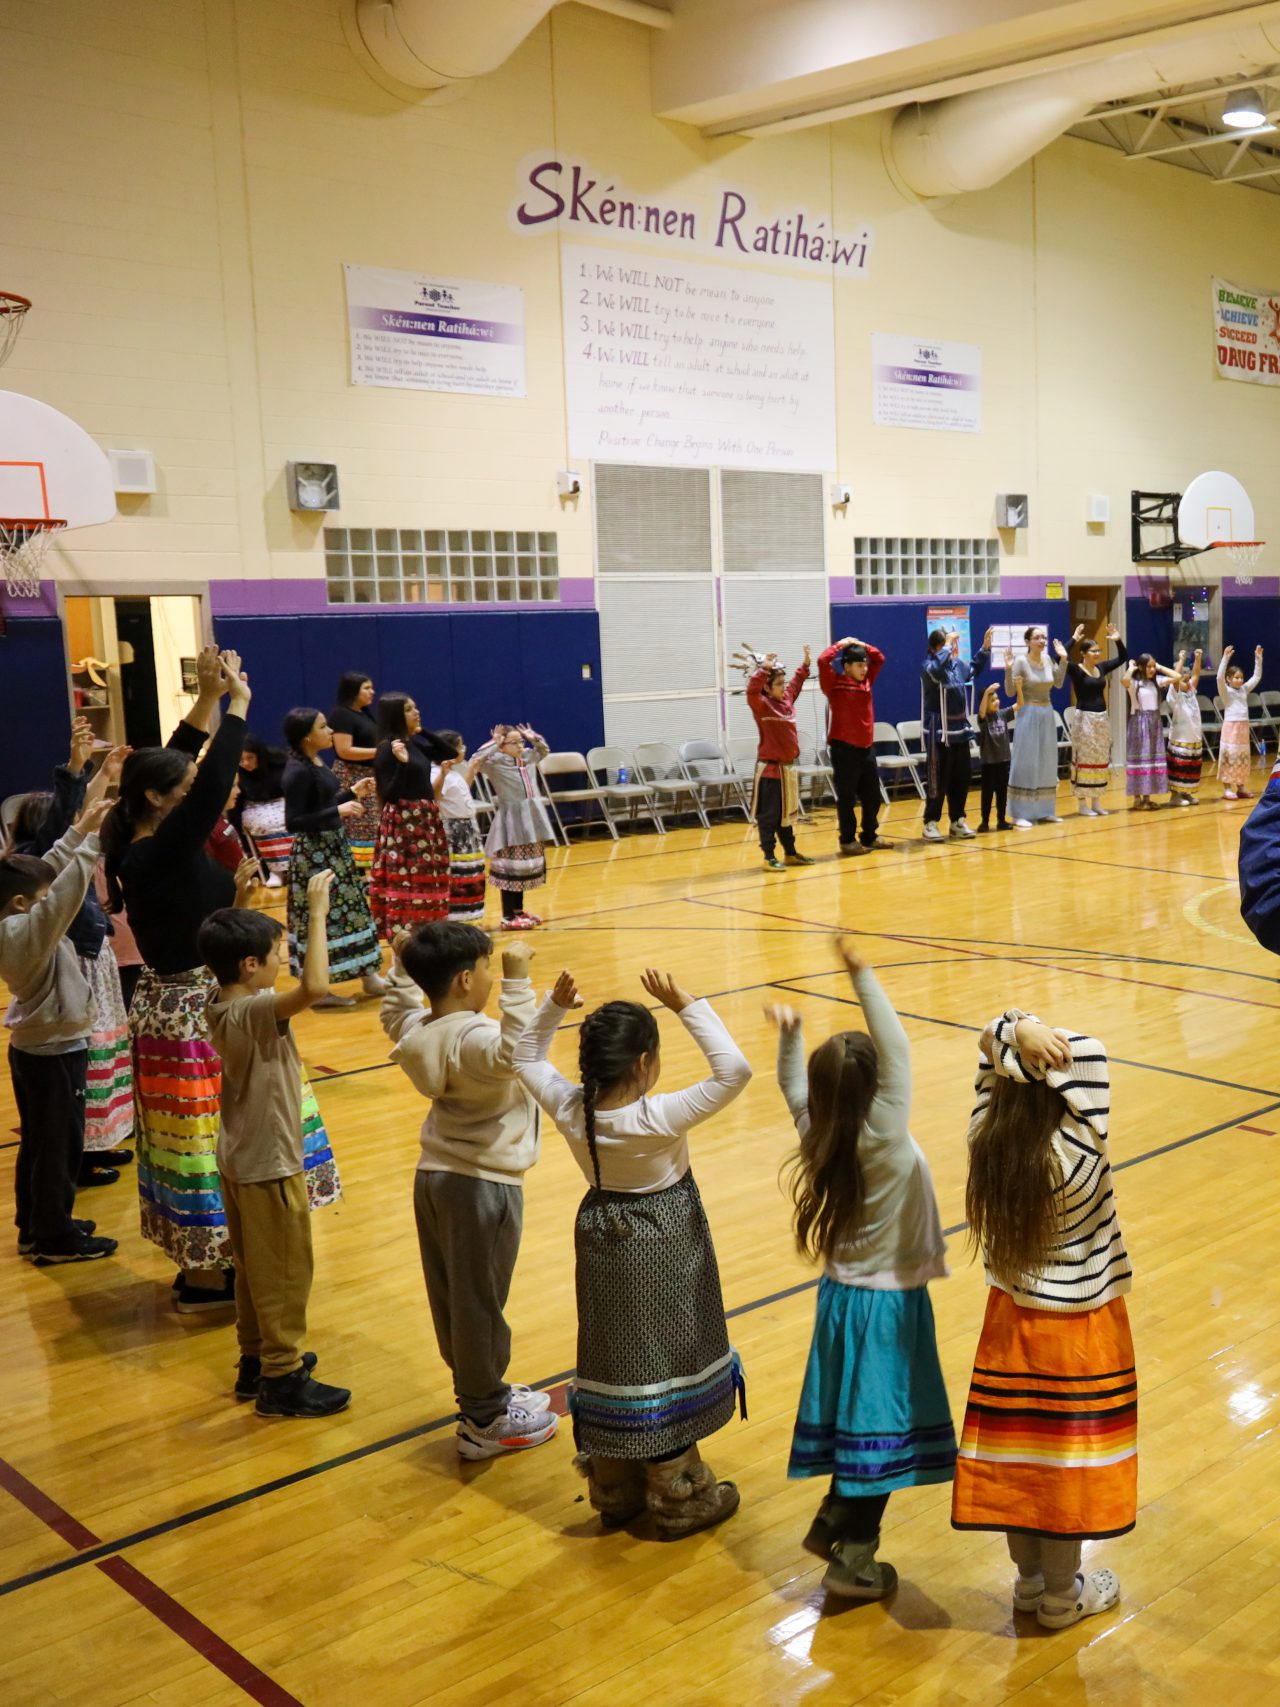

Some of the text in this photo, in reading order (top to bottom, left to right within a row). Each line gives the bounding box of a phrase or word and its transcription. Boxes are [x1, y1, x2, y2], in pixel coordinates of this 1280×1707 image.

[516, 161, 868, 269] Skén:nen Ratihá:wi
[579, 263, 592, 278] 1.
[596, 264, 614, 282] We
[618, 267, 650, 287] WILL
[655, 274, 684, 292] NOT
[685, 281, 697, 296] be
[699, 286, 727, 299] mean
[730, 288, 740, 301] to
[579, 288, 593, 305] 2.
[597, 291, 615, 310] We
[619, 295, 651, 314] WILL
[654, 303, 671, 324] try
[675, 305, 684, 319] to
[686, 305, 696, 320] be
[724, 313, 736, 325] to
[1218, 288, 1259, 310] BELIEVE
[382, 313, 436, 332] Skén:nen
[580, 314, 593, 332] 3.
[597, 319, 615, 336] We
[620, 321, 650, 340] WILL
[654, 329, 671, 352] try
[673, 332, 682, 345] to
[683, 329, 704, 353] help
[1219, 326, 1258, 345] SUCCEED
[582, 342, 597, 359] 4.
[597, 346, 615, 363] We
[619, 349, 649, 366] WILL
[1217, 344, 1256, 371] DRUG
[646, 431, 680, 457] Change
[718, 437, 743, 452] With
